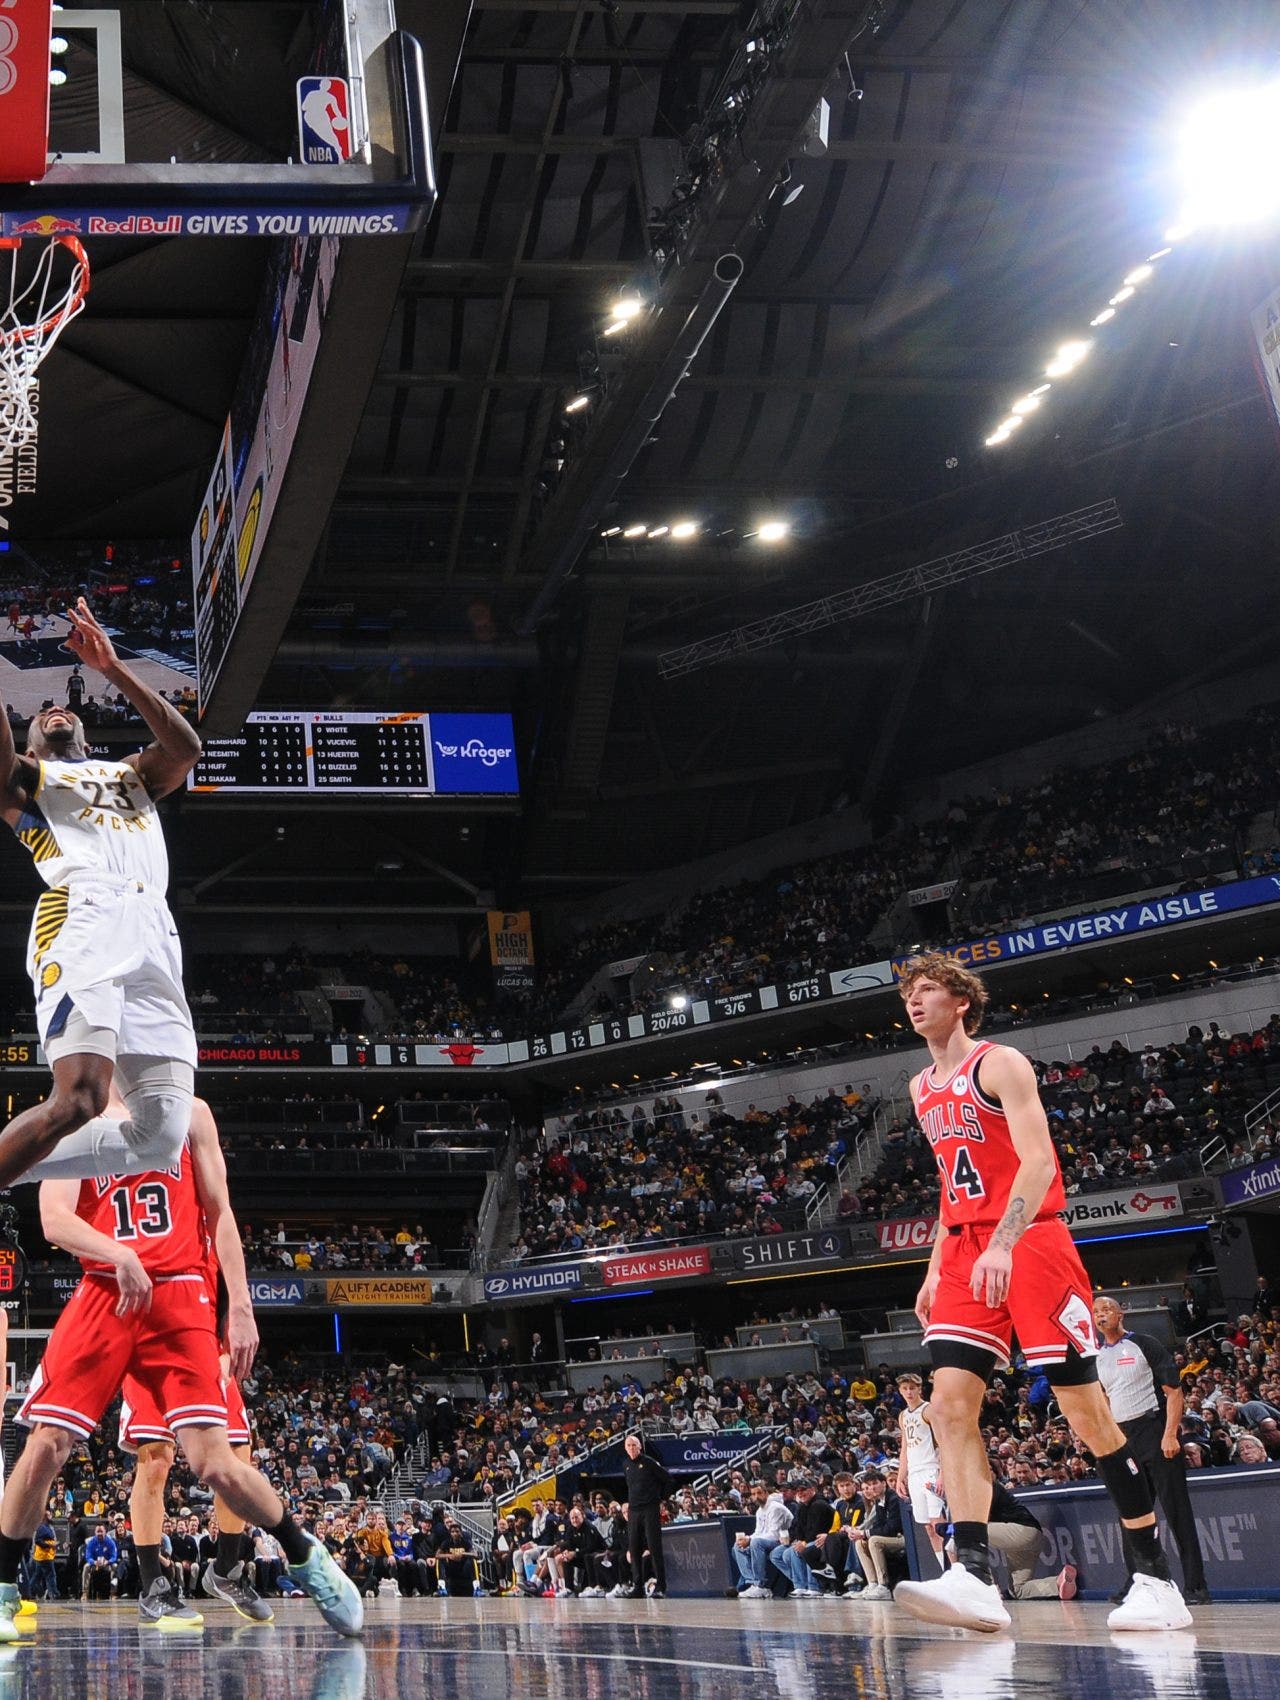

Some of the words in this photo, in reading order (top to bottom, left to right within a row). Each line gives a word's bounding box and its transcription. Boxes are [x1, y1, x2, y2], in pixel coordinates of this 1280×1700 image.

[308, 146, 333, 162] NBA
[187, 214, 249, 235] GIVES
[256, 215, 302, 235] YOU
[460, 739, 512, 767] Kroger
[81, 781, 136, 811] 23
[1008, 931, 1036, 954] IN
[1042, 911, 1129, 946] EVERY
[1138, 891, 1219, 926] AISLE
[497, 978, 521, 986] LUCAS
[522, 978, 534, 986] OIL
[789, 985, 821, 1002] 6/13
[651, 1010, 667, 1019] FIELD
[724, 1002, 746, 1016] 3/6
[651, 1014, 687, 1032] 20/40
[570, 1036, 586, 1048] 12
[612, 1028, 621, 1039] 0
[199, 1049, 256, 1061] CHICAGO
[258, 1049, 301, 1060] BULLS
[358, 1052, 366, 1064] 3
[399, 1052, 408, 1063] 6
[533, 1044, 548, 1057] 26
[936, 1145, 986, 1205] 14
[1242, 1164, 1280, 1196] xfinit
[110, 1181, 174, 1241] 13
[1058, 1200, 1128, 1225] eyBank
[742, 1238, 813, 1265] SHIFT
[824, 1237, 836, 1252] 4
[605, 1261, 649, 1279] STEAK
[648, 1263, 657, 1272] N
[658, 1255, 705, 1273] SHAKE
[347, 1281, 370, 1293] LIFT
[372, 1281, 427, 1293] ACADEMY
[512, 1269, 580, 1290] HYUNDAI
[249, 1283, 301, 1300] IGMA
